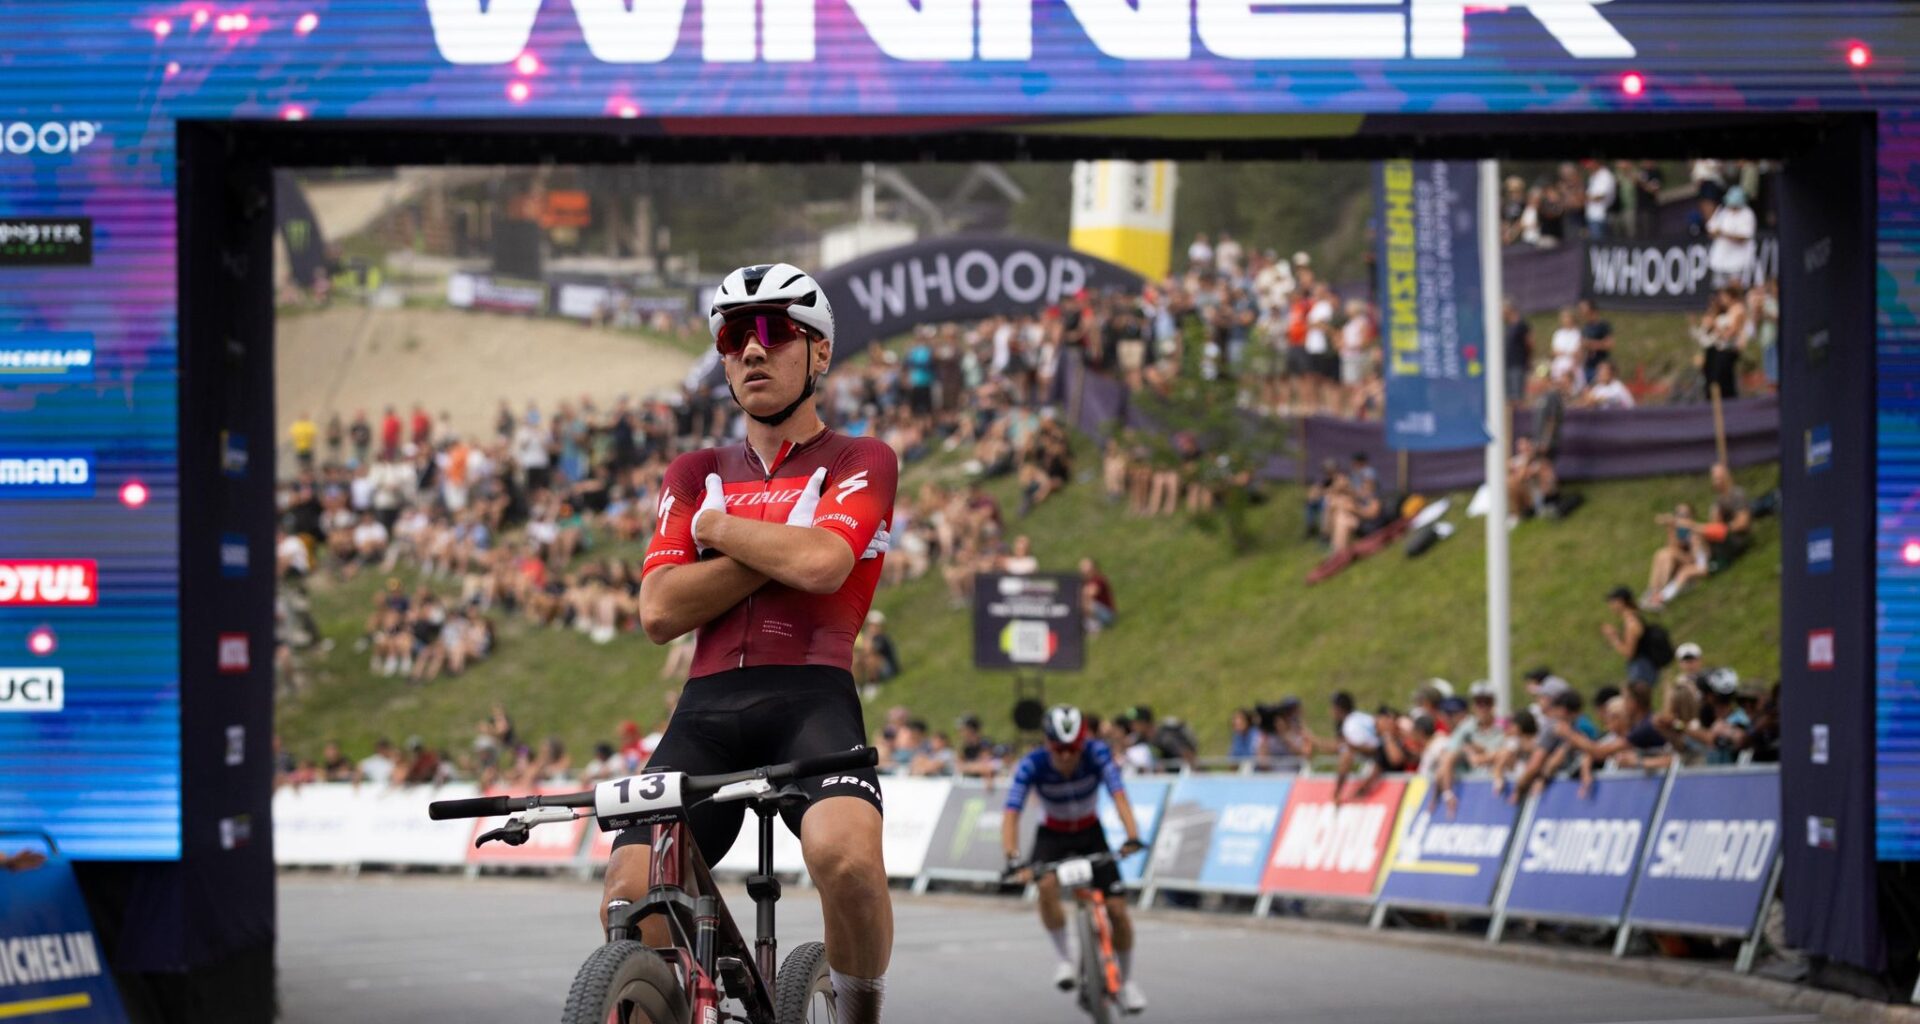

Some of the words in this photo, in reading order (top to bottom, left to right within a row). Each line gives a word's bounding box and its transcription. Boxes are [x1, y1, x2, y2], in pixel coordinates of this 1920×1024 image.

[0, 121, 96, 154] OOP
[850, 250, 1086, 324] WHOOP
[1589, 245, 1708, 297] WHOOP
[613, 774, 666, 804] 13
[1274, 802, 1387, 872] MOTUL
[1521, 818, 1643, 876] SHIMANO
[1649, 819, 1778, 882] SHIMANO
[0, 931, 102, 986] ICHELIN
